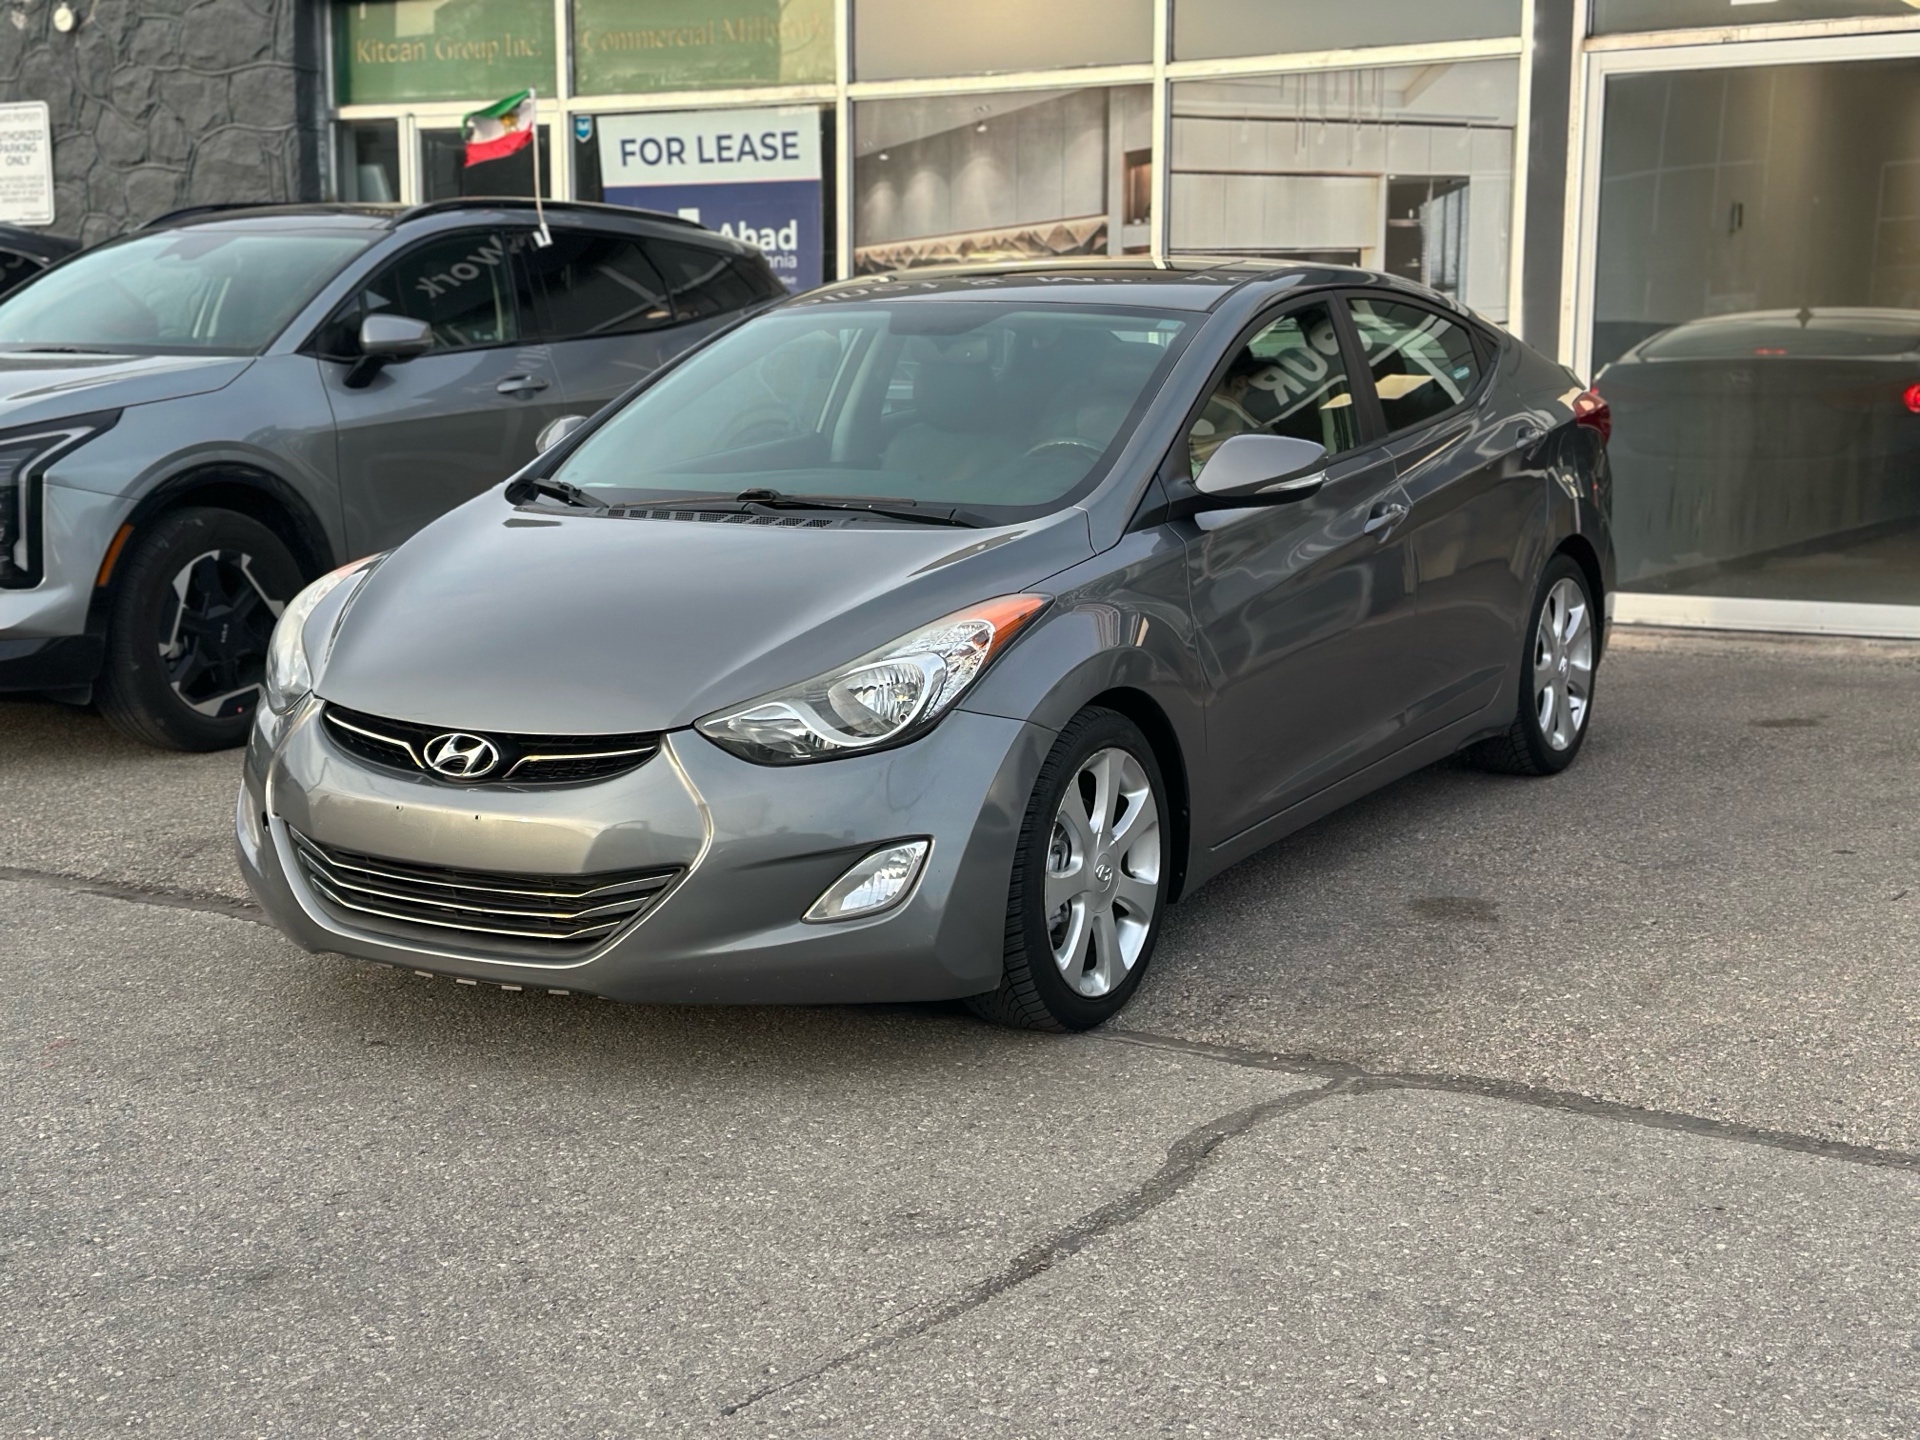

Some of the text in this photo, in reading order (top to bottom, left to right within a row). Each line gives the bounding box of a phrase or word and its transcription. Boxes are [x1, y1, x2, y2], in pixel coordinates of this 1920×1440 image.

[356, 38, 426, 64] Kitcan
[434, 36, 498, 65] Group
[581, 18, 714, 52] Commercial
[6, 154, 30, 166] ONLY
[620, 131, 800, 167] FOR LEASE
